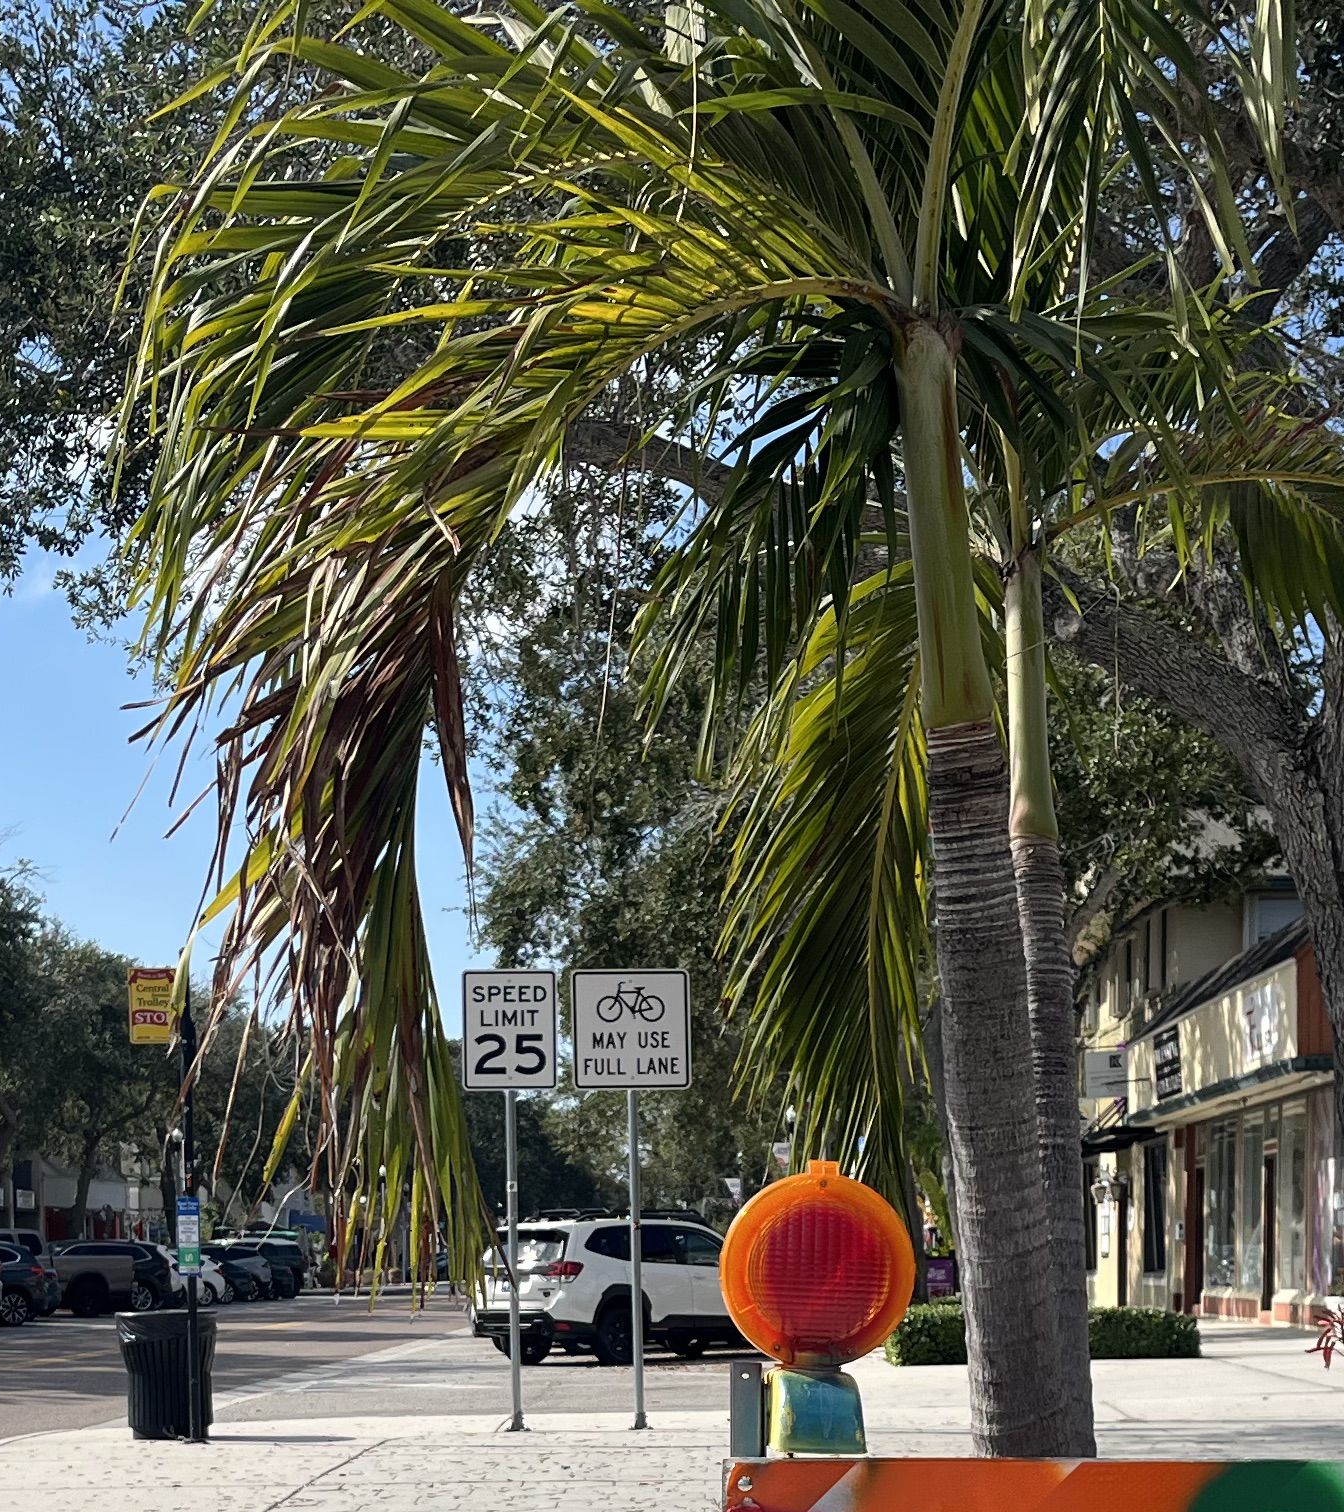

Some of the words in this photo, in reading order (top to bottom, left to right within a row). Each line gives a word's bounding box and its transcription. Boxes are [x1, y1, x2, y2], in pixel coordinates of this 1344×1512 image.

[136, 984, 169, 993] Central
[472, 985, 547, 1003] SPEED
[136, 997, 169, 1008] Trolley
[135, 1012, 169, 1024] STO
[480, 1009, 539, 1027] LIMIT
[592, 1031, 627, 1049] MAY
[638, 1031, 671, 1048] USE
[474, 1033, 547, 1075] 25
[584, 1058, 626, 1075] FULL
[637, 1057, 680, 1074] LANE
